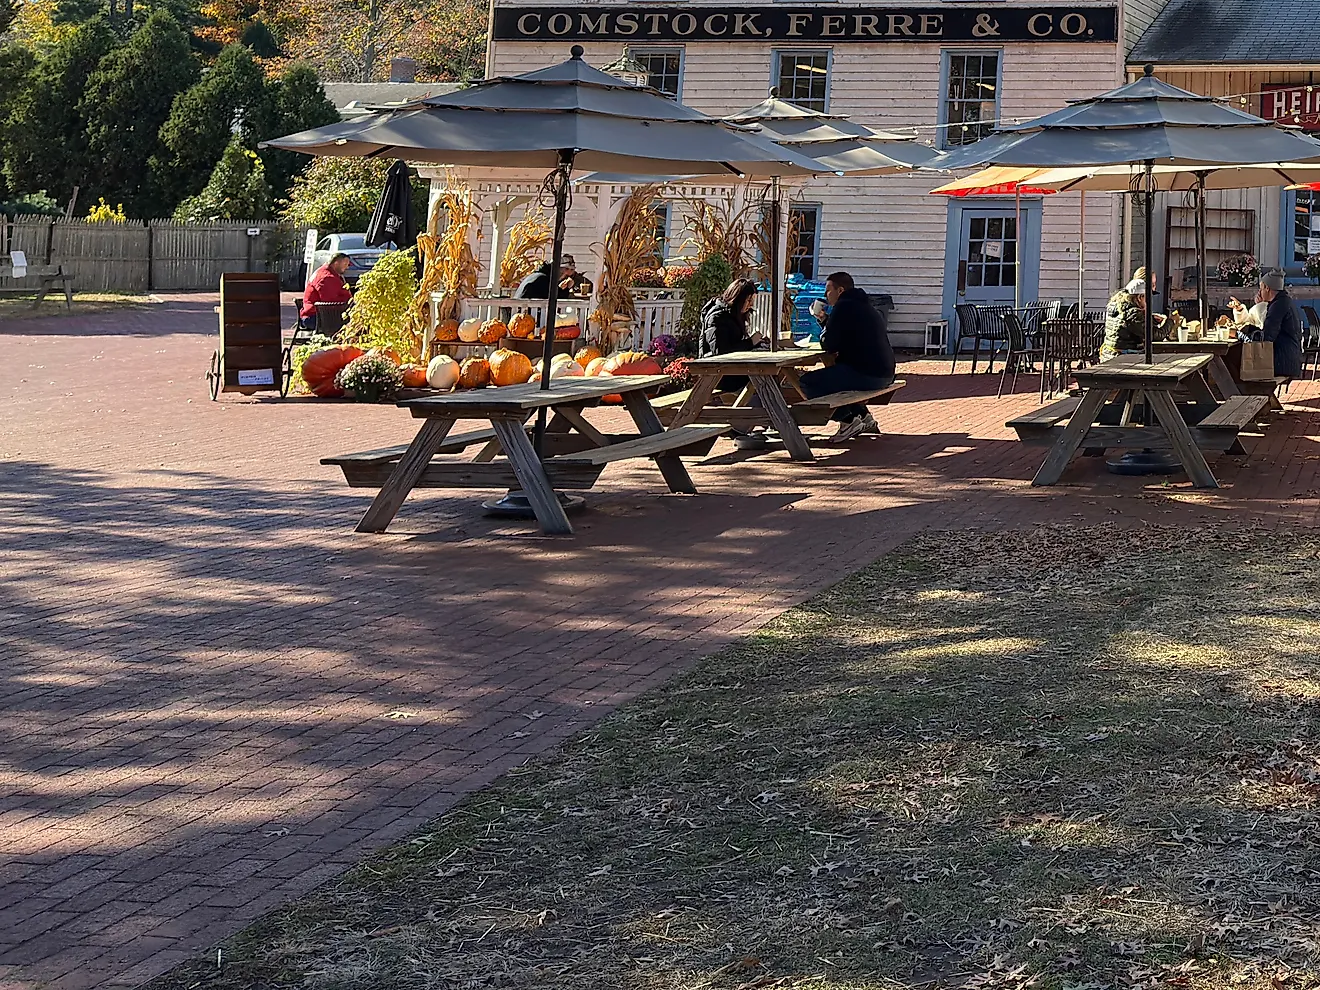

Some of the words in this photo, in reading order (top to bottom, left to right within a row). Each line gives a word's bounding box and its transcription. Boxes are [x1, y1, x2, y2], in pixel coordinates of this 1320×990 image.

[516, 12, 773, 37] COMSTOCK,
[785, 13, 944, 36] FERRE
[971, 13, 1001, 36] &
[1027, 13, 1095, 36] CO.
